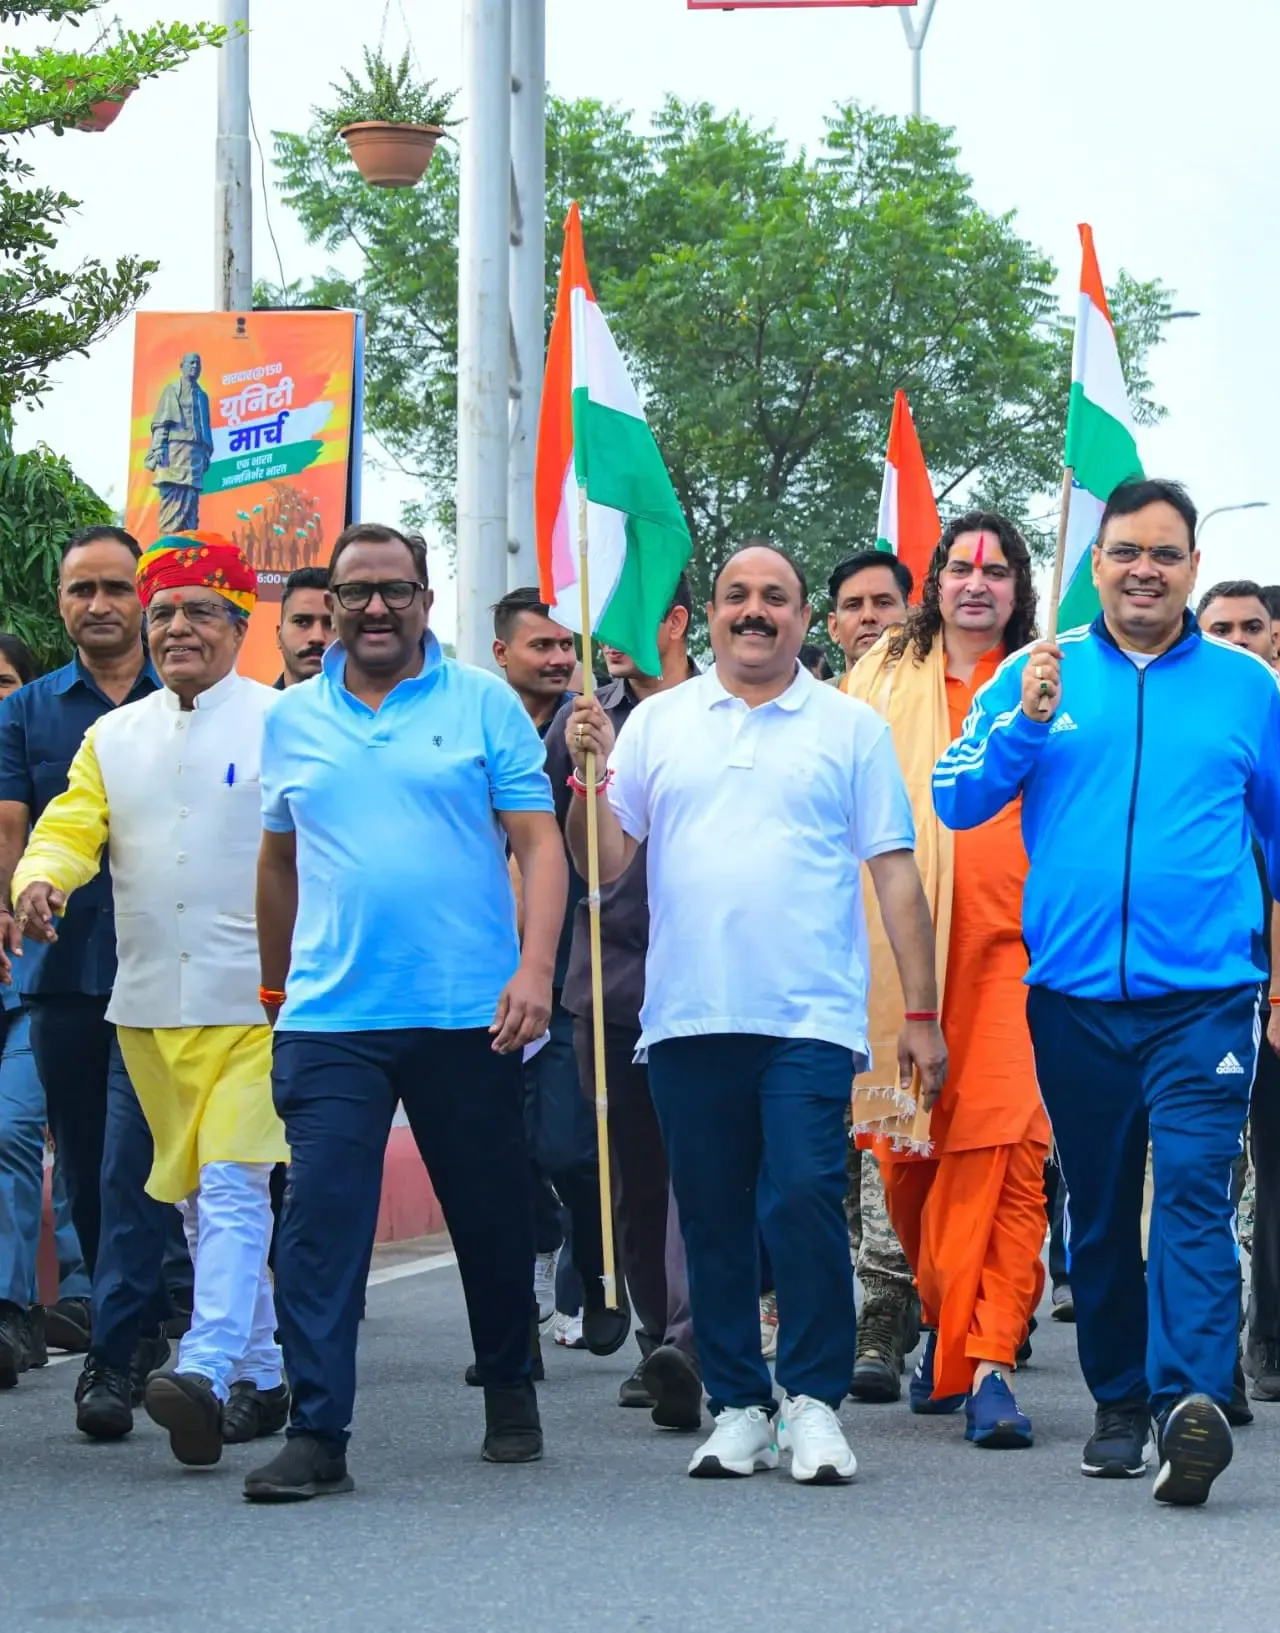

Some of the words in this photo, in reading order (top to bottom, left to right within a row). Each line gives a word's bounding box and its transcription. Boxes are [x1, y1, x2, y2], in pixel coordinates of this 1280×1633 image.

[219, 376, 295, 426] यूनिटी
[228, 411, 290, 452] मार्च
[236, 457, 250, 470] एक
[251, 453, 273, 466] भारत
[265, 464, 288, 477] भारत
[257, 573, 281, 584] 6:00
